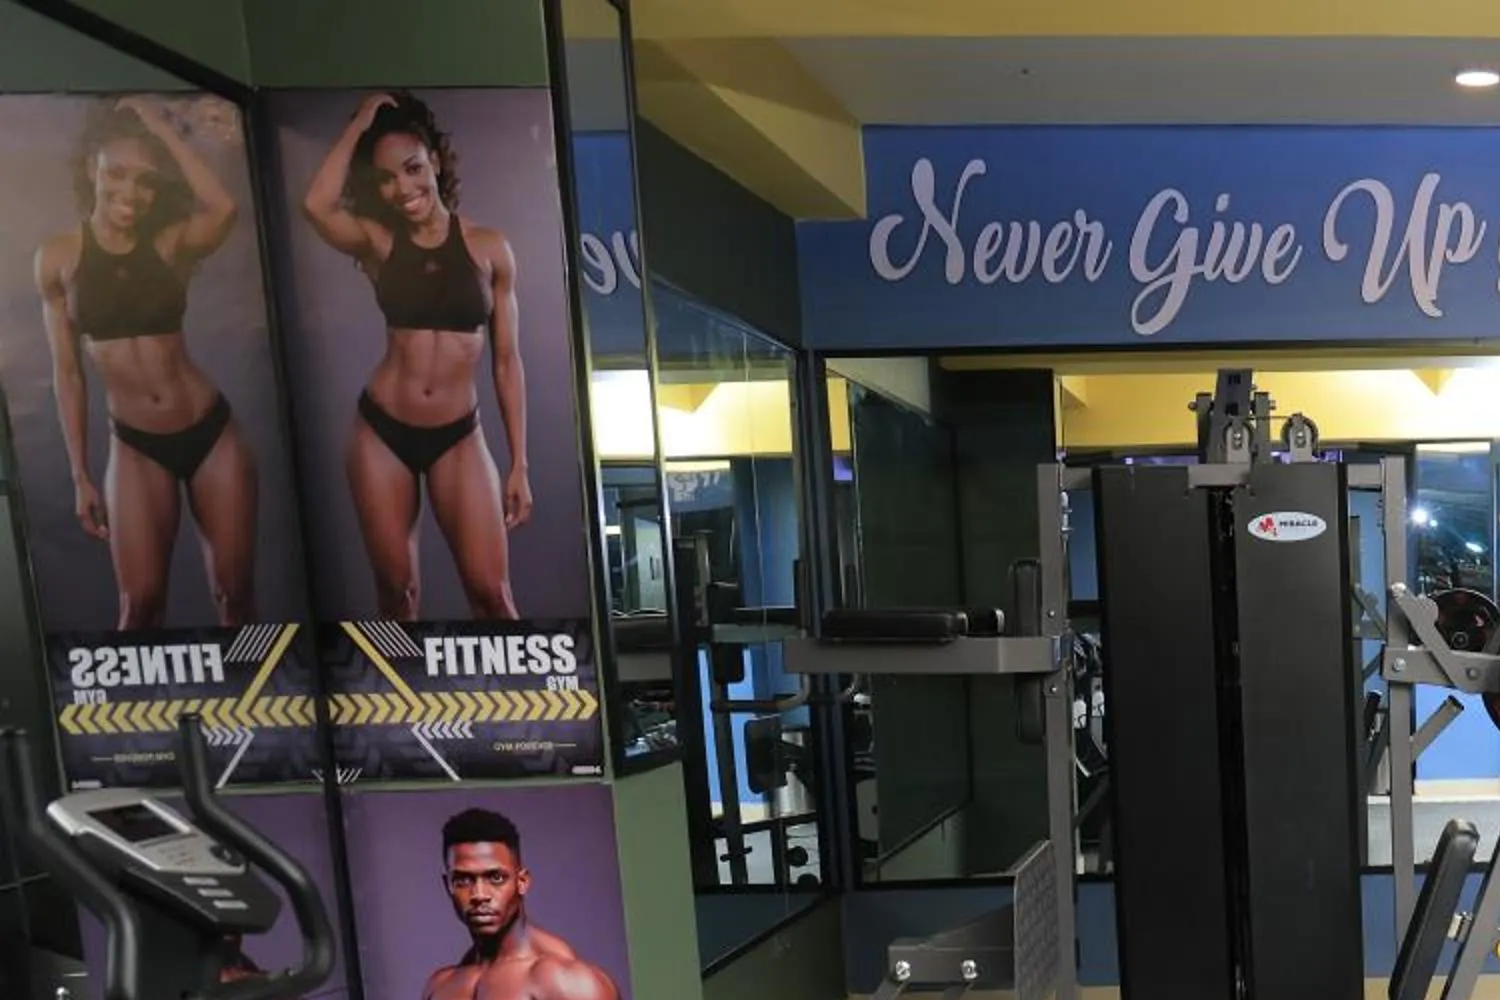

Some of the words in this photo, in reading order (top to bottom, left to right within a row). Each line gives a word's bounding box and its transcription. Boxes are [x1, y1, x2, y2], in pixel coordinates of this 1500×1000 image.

[869, 157, 1112, 285] Never
[1129, 188, 1304, 336] Give
[424, 634, 577, 676] FITNESS
[545, 675, 580, 692] GYM
